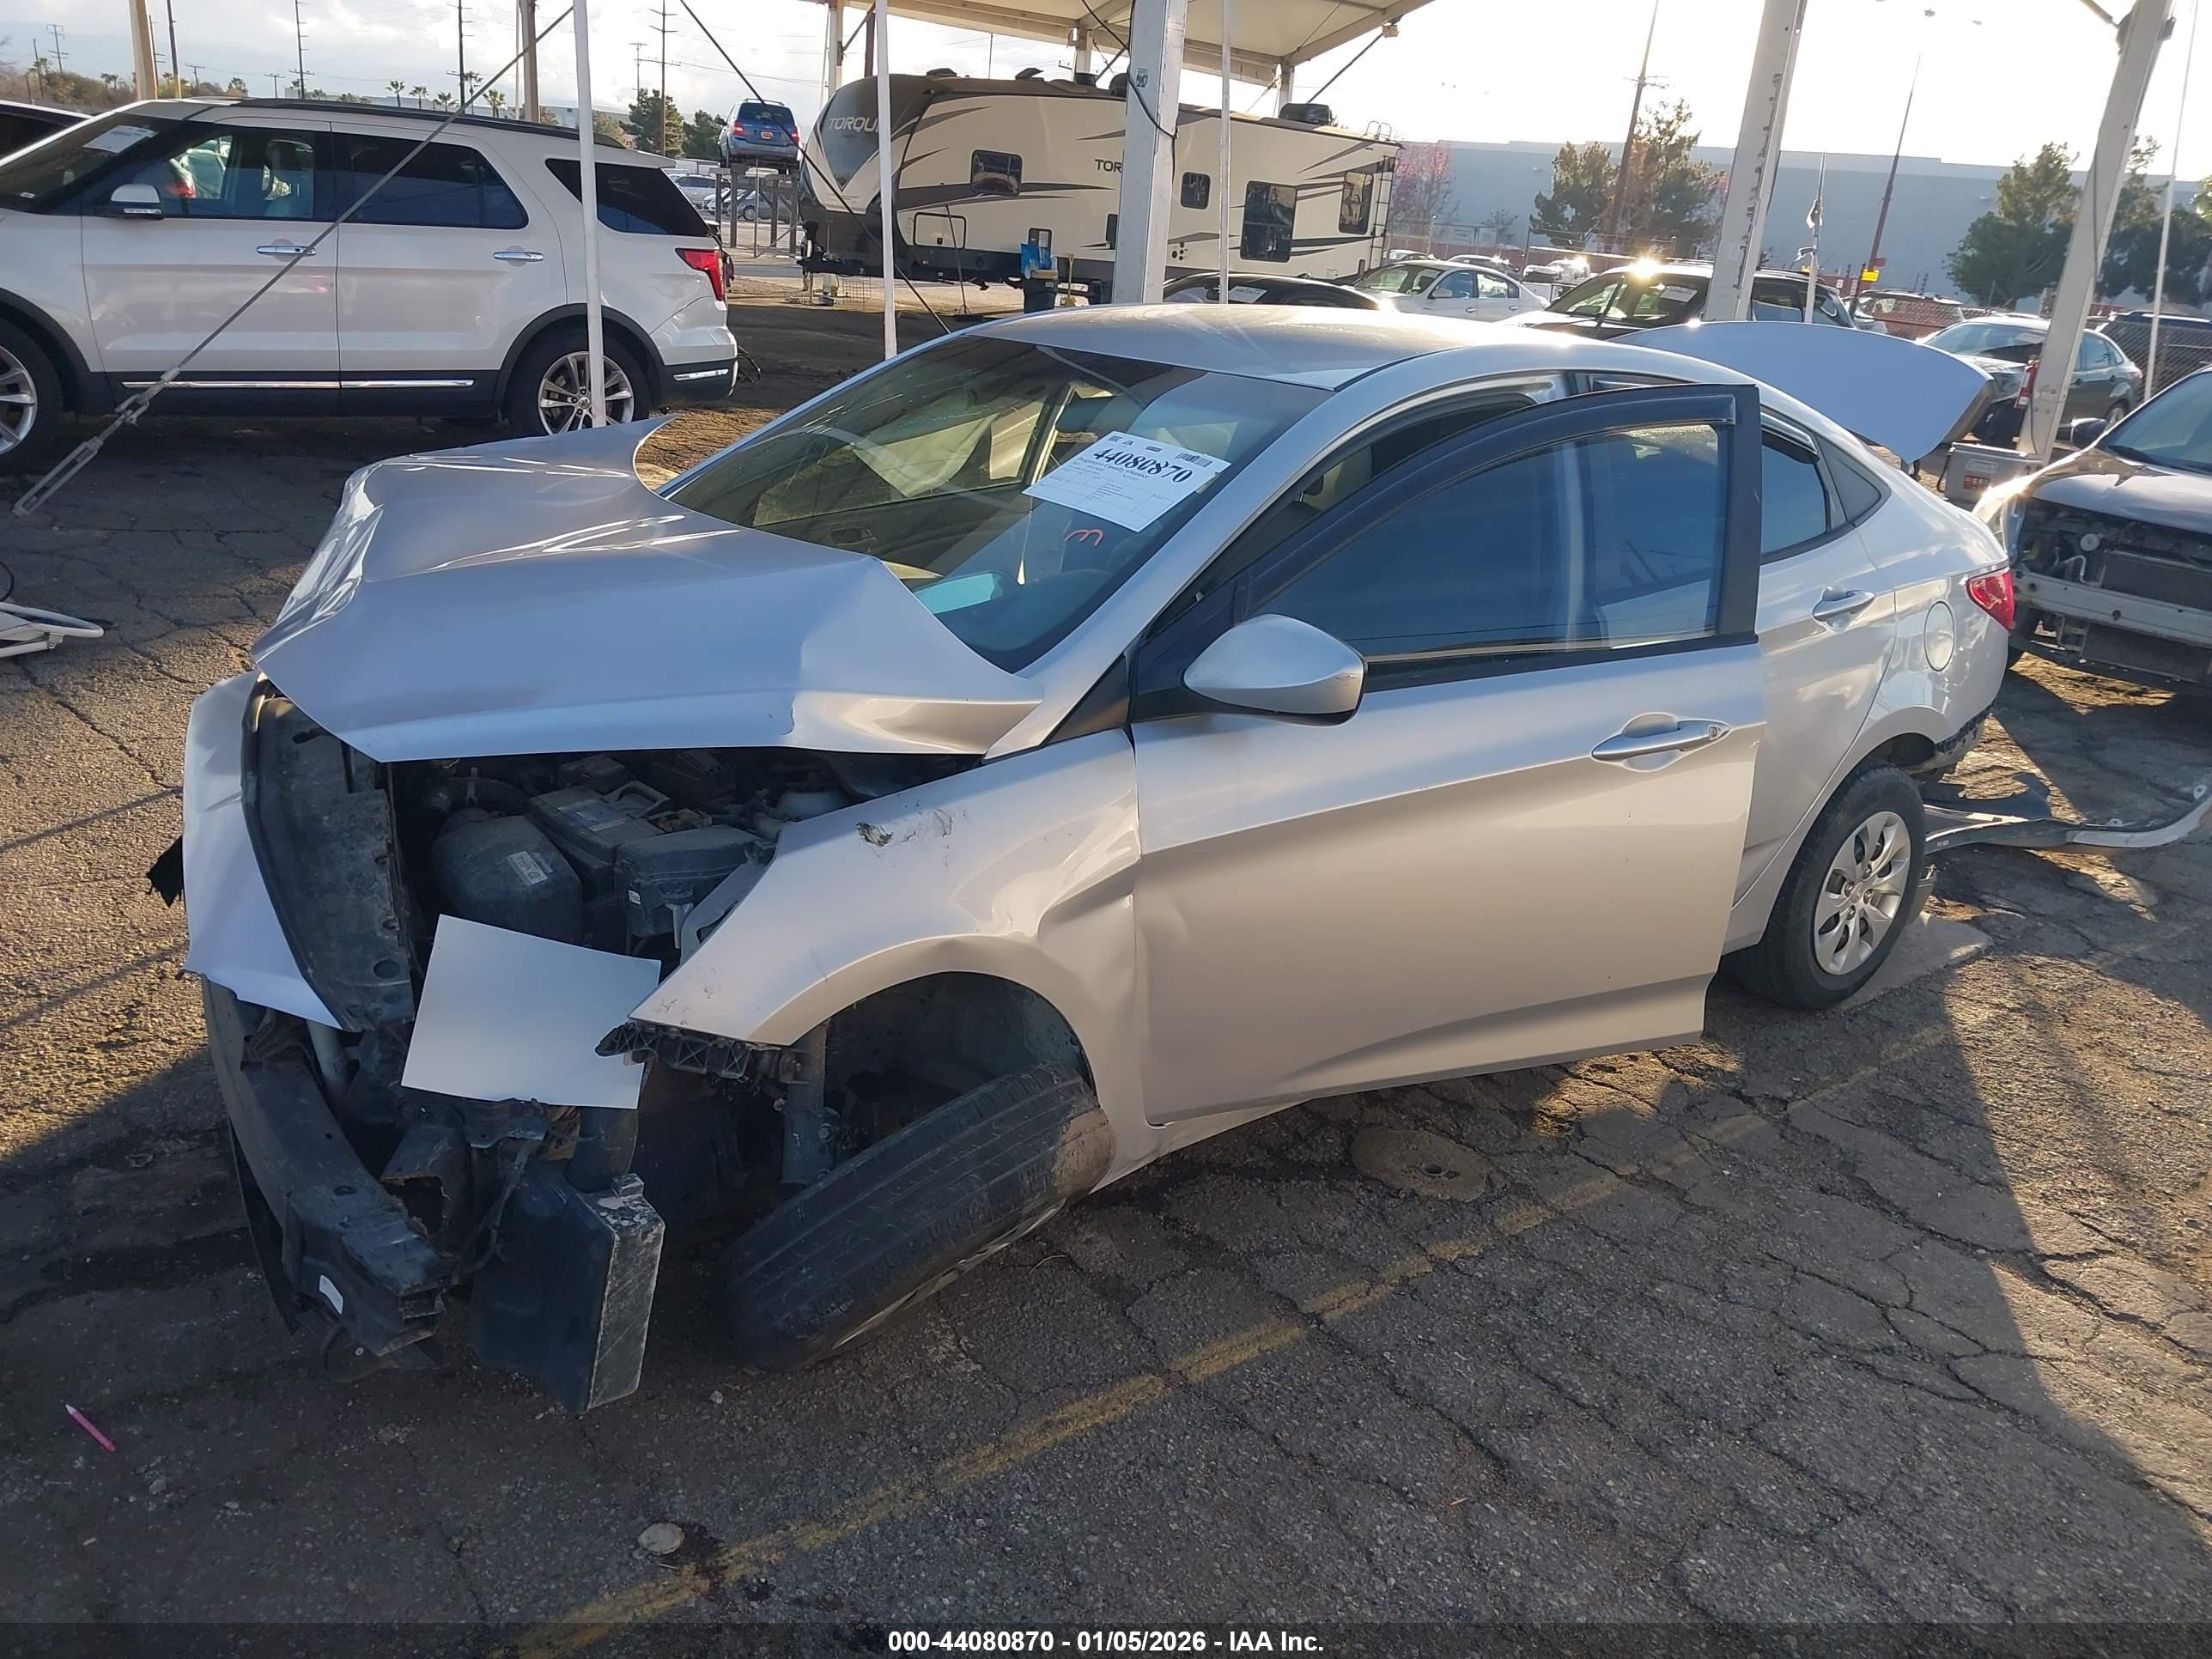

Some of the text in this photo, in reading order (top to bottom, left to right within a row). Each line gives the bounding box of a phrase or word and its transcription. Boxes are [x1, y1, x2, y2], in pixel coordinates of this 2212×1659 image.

[830, 117, 878, 132] TORQU
[1095, 159, 1121, 173] TOR
[1092, 447, 1194, 483] 44080870
